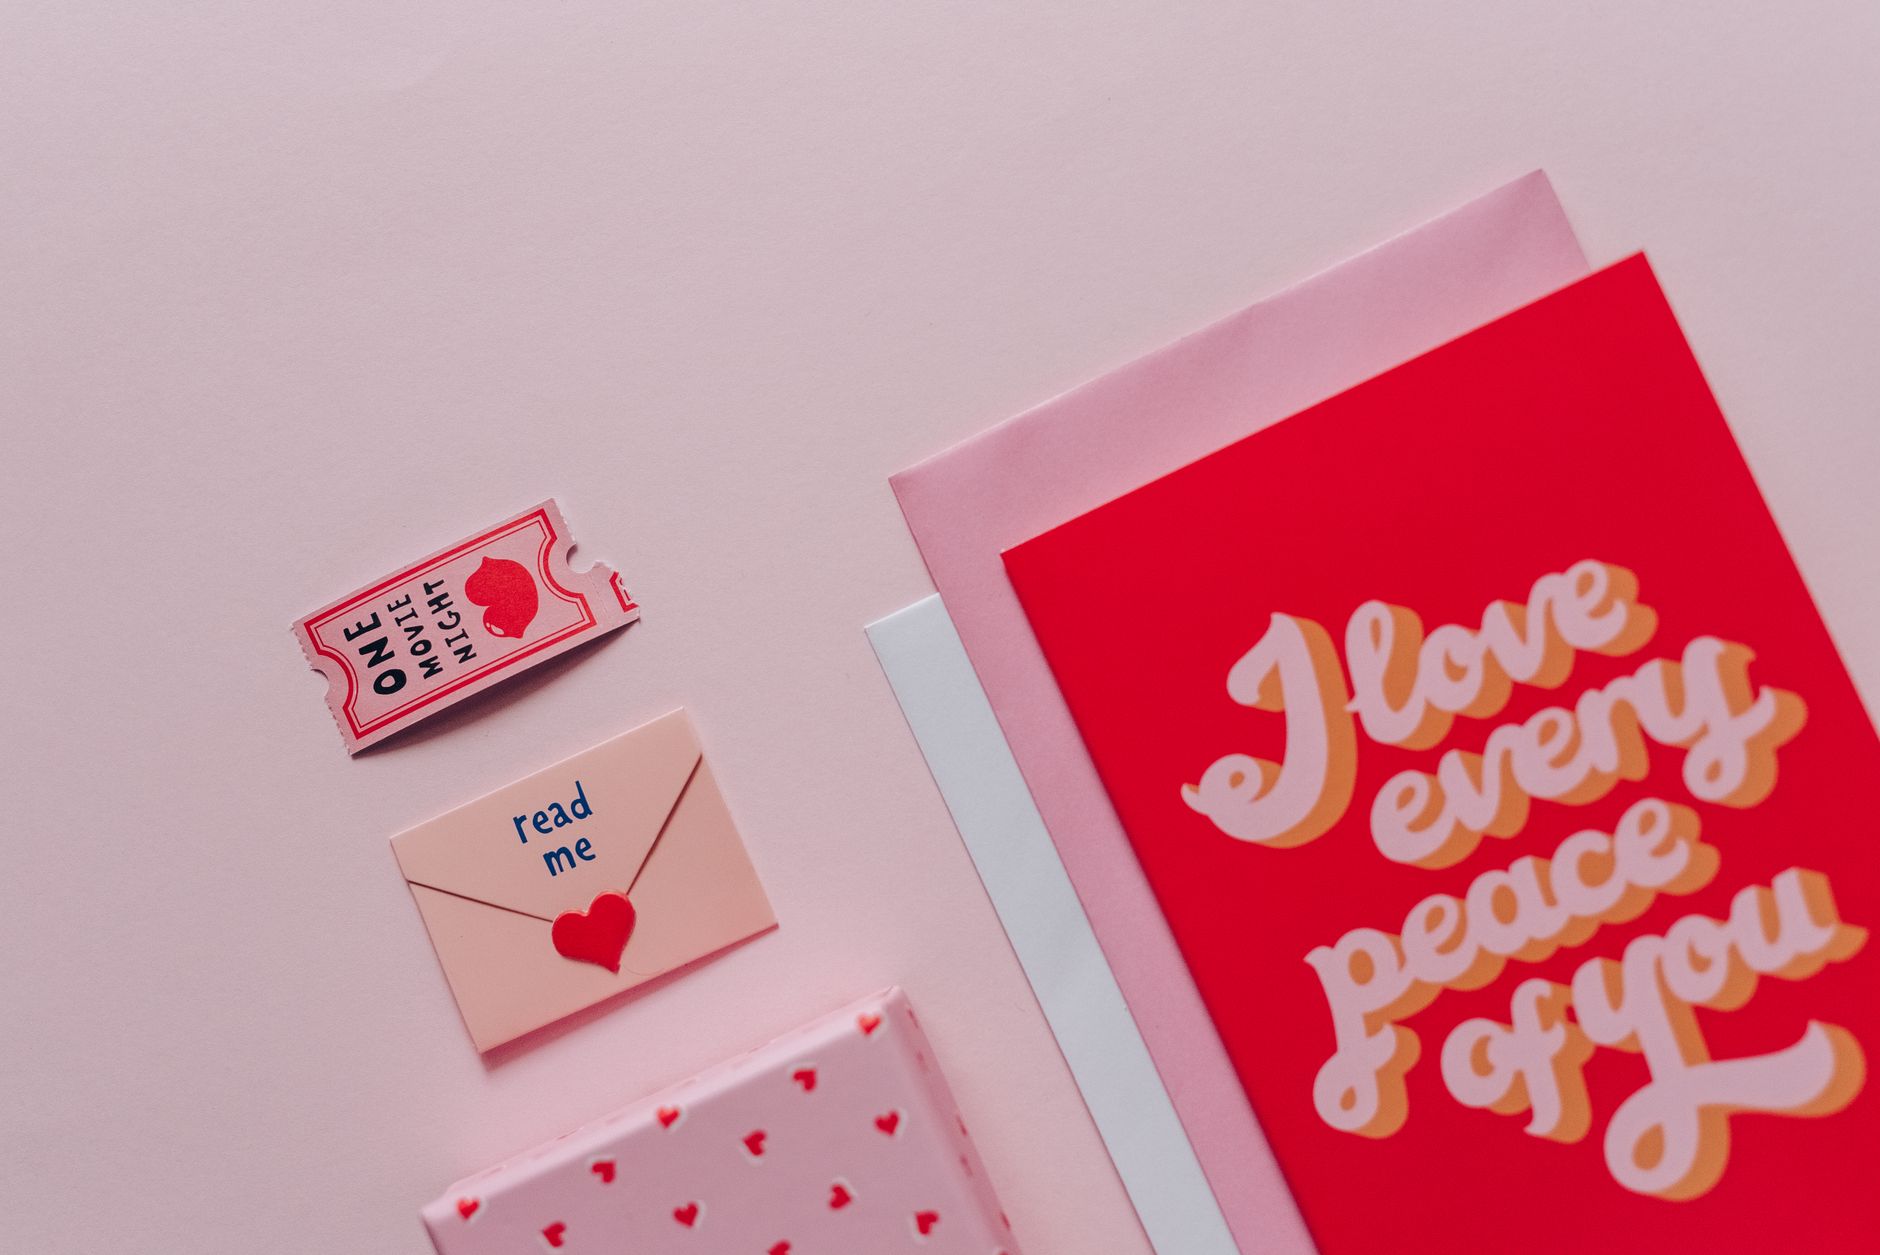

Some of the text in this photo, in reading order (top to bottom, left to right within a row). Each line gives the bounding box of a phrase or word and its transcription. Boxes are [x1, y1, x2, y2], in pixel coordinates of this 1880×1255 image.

[343, 611, 407, 695] ONE
[387, 594, 443, 679] MOVIE
[423, 579, 477, 664] NIGHT
[1180, 559, 1658, 848] I love
[1370, 635, 1808, 870] every
[513, 780, 593, 844] read
[543, 838, 596, 876] me
[1303, 797, 1720, 1139] peace
[1440, 977, 1596, 1143] of
